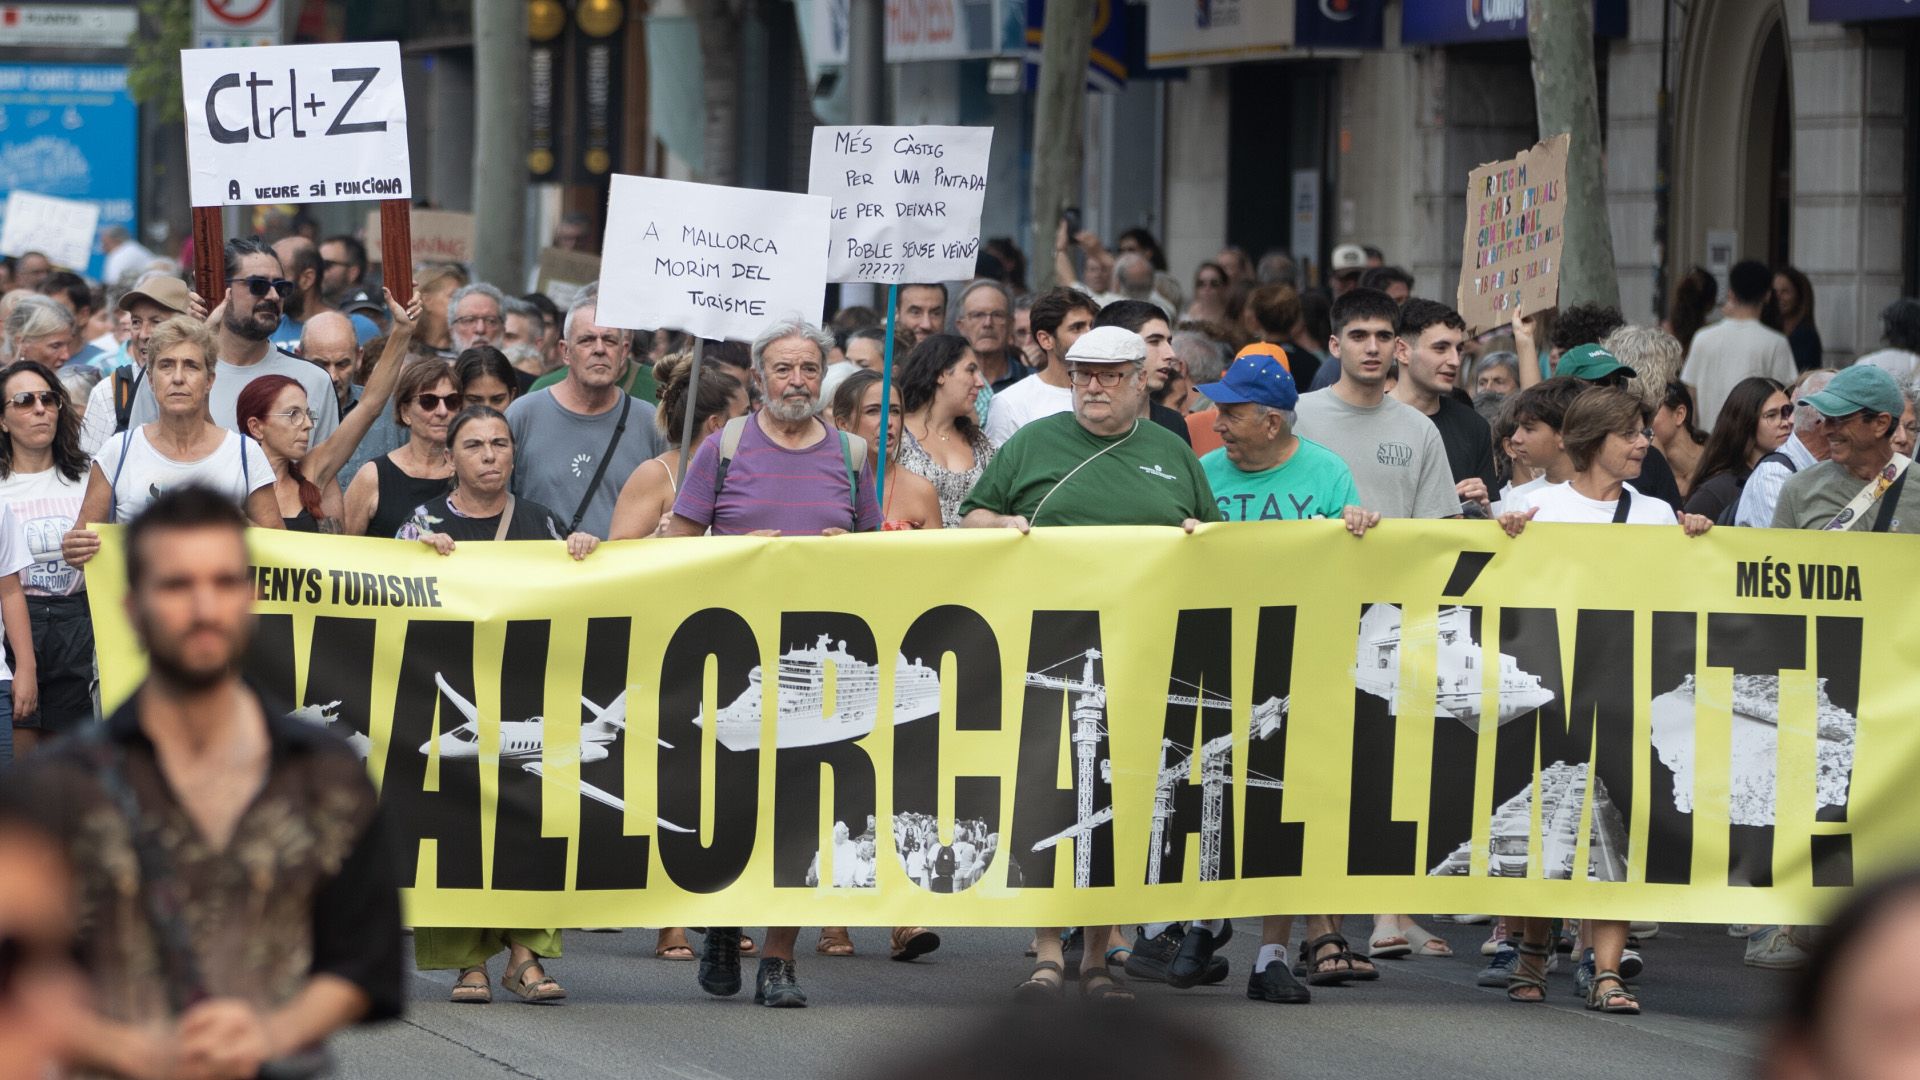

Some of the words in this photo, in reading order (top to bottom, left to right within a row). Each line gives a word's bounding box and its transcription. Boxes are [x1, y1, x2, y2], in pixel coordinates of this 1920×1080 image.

[205, 67, 387, 144] Ctrl+Z
[835, 129, 872, 155] MÉS
[894, 134, 944, 158] CÀSTIG
[228, 179, 241, 200] A
[255, 184, 300, 199] VEURE
[846, 170, 874, 187] PER
[894, 169, 920, 184] UNA
[1479, 163, 1527, 199] PROTEGM
[831, 207, 848, 219] UE
[857, 203, 885, 218] PER
[643, 221, 660, 241] A
[682, 225, 778, 255] MALLORCA
[847, 238, 893, 259] POBLE
[902, 242, 936, 258] SENSE
[732, 263, 771, 281] DEL
[329, 570, 442, 608] TURISME
[1736, 556, 1792, 599] MÉS
[1798, 564, 1863, 601] VIDA
[1144, 605, 1305, 886] AL
[1347, 551, 1864, 888] LÍMIT!
